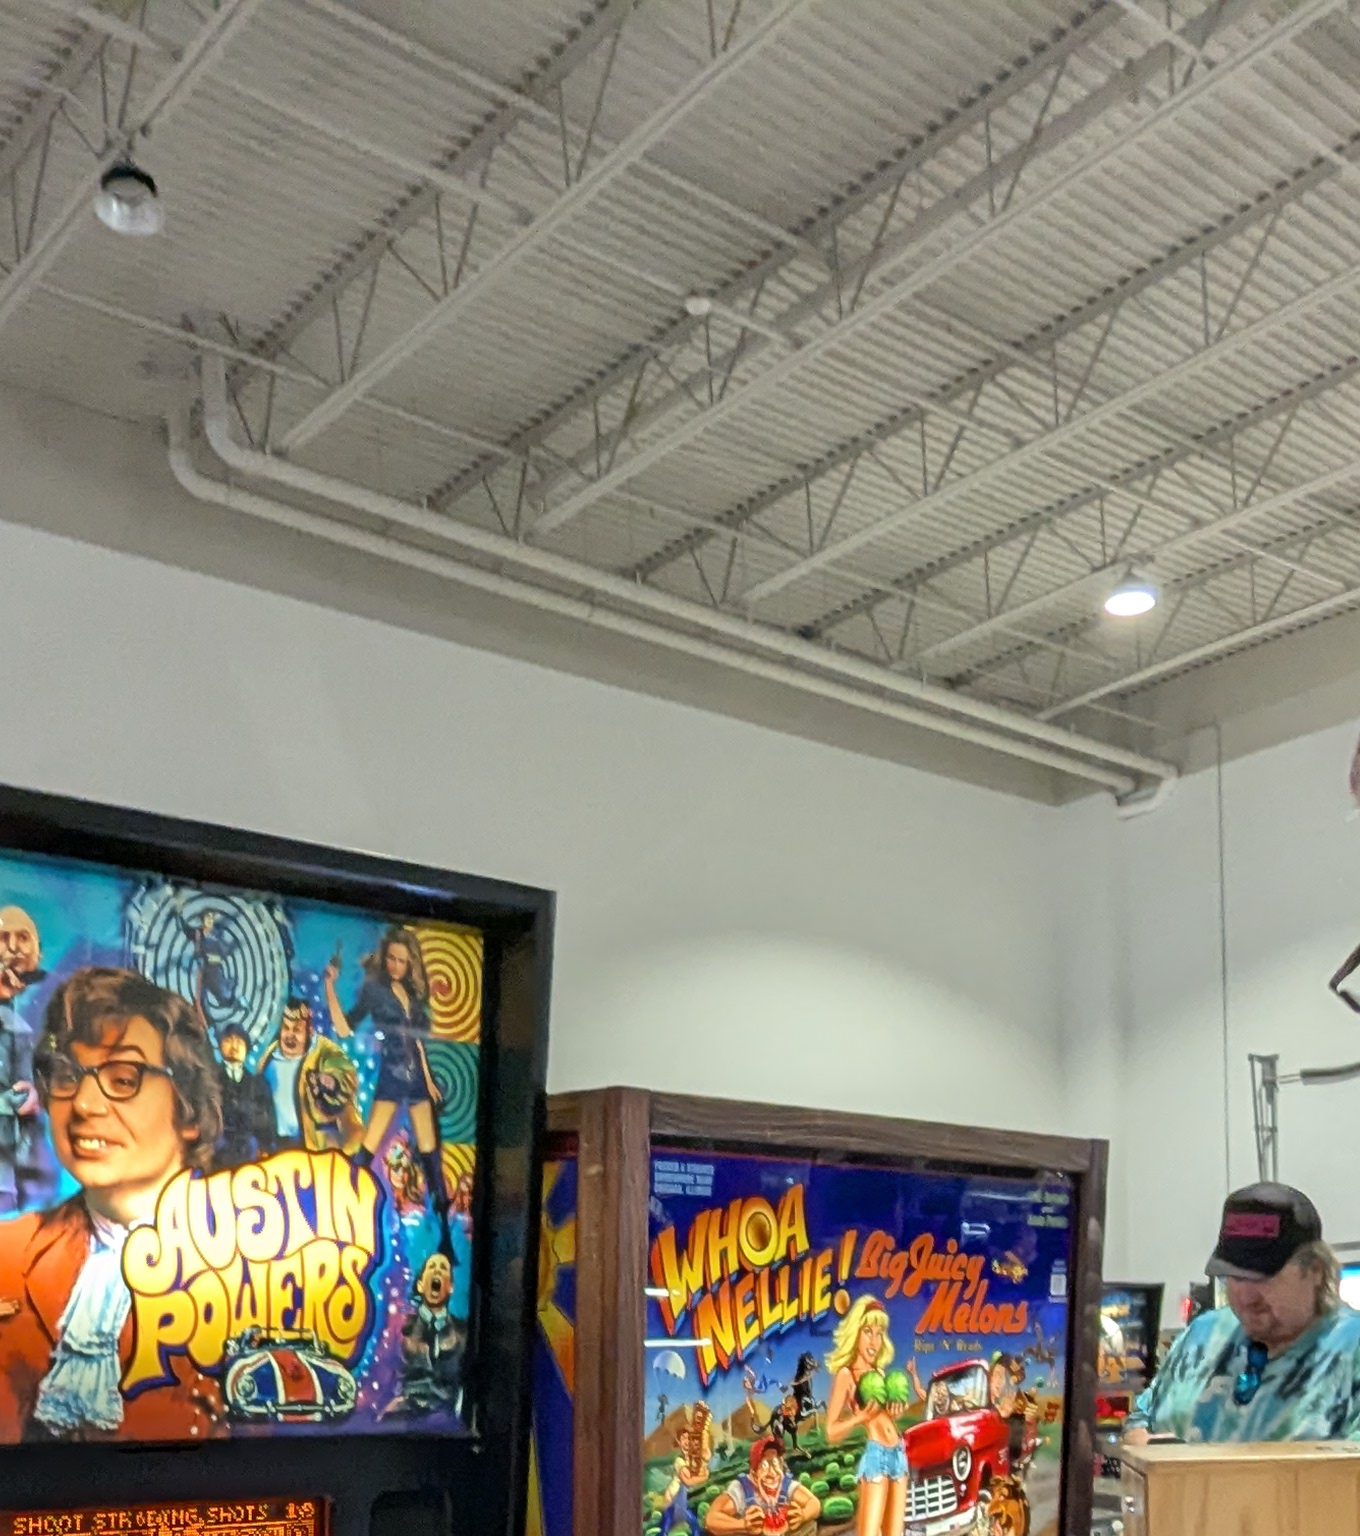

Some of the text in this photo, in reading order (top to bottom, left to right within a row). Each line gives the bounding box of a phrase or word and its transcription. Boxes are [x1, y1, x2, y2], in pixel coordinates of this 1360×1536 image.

[123, 1151, 376, 1294] AUSTIN
[652, 1183, 809, 1330] WHOA
[855, 1230, 909, 1298] Big
[904, 1233, 985, 1299] Juicy
[121, 1238, 371, 1391] POWERS
[694, 1229, 857, 1380] NELLIE!
[915, 1279, 1028, 1334] Melons
[13, 1513, 84, 1536] SHOOT
